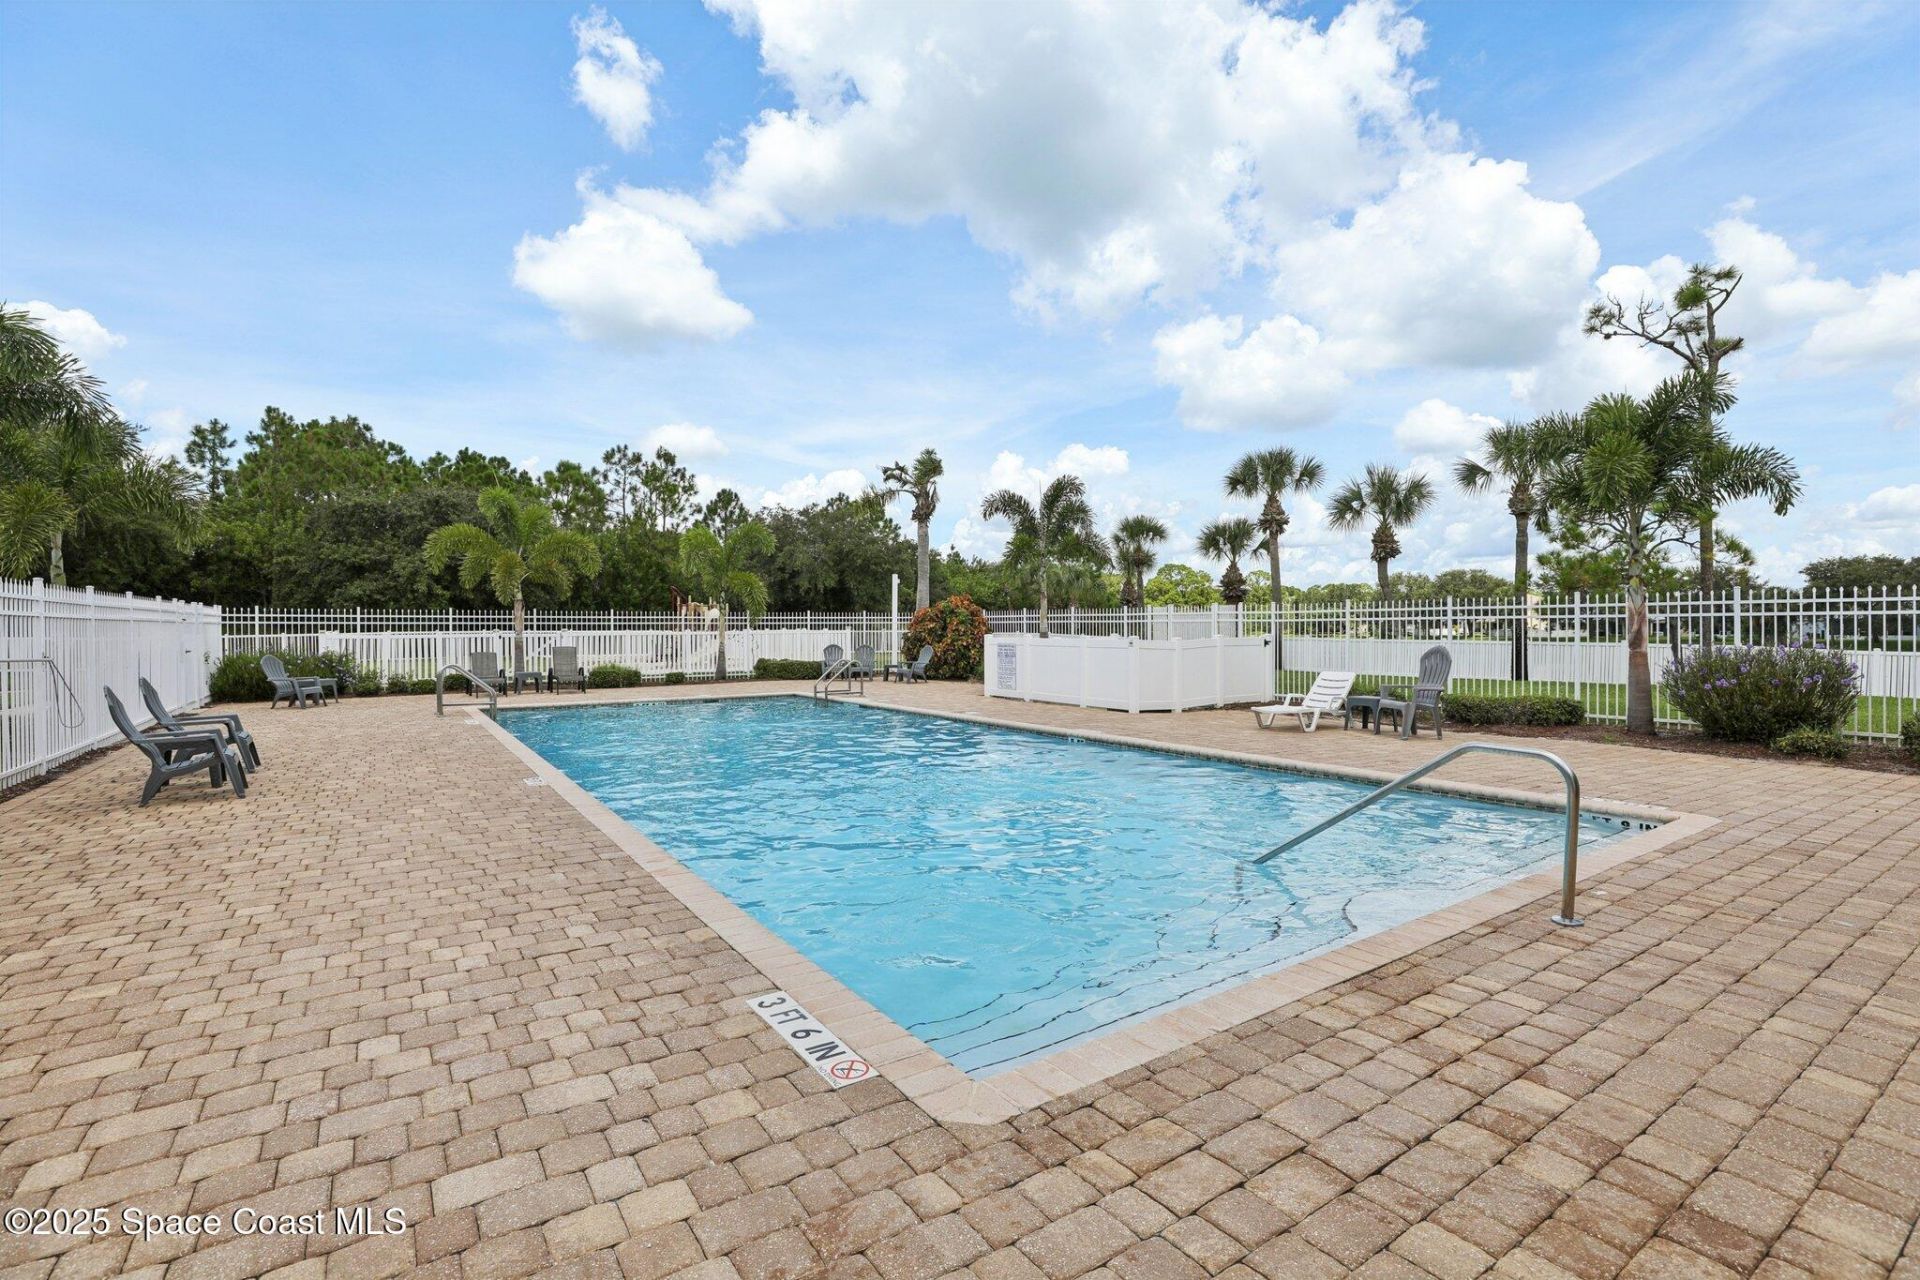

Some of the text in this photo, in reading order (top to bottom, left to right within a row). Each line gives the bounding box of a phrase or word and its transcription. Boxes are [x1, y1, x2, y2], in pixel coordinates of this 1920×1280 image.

[757, 997, 847, 1061] 3 FT 6 IN
